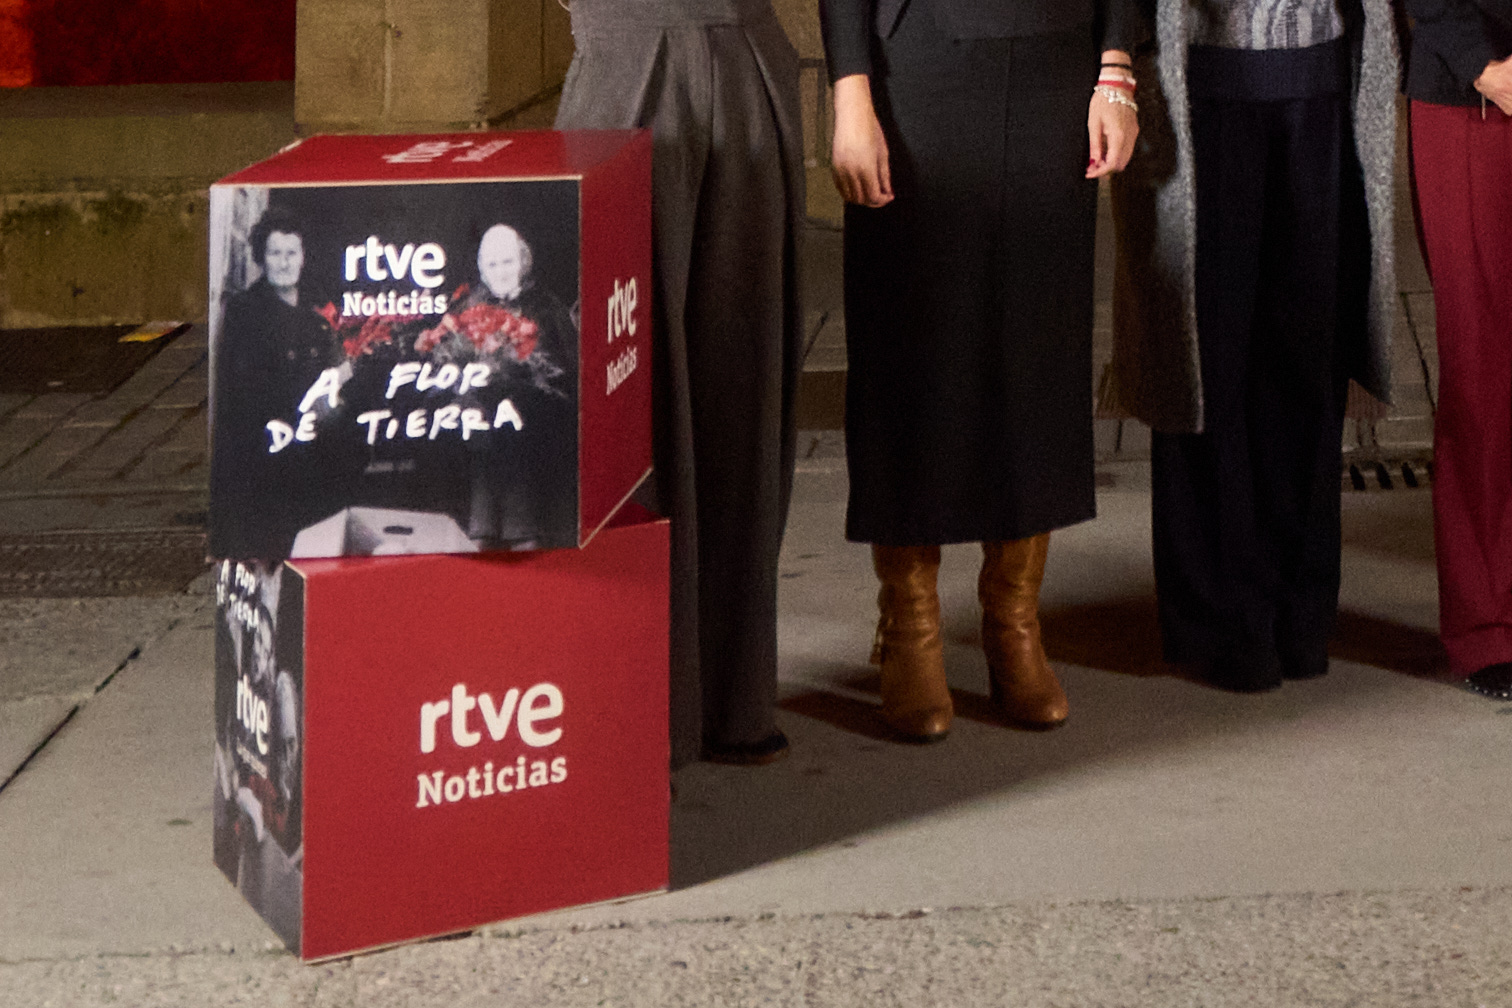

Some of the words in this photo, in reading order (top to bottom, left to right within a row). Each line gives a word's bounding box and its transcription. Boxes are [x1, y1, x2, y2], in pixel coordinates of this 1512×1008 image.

[344, 235, 447, 288] rtve
[342, 289, 448, 317] Noticias
[607, 276, 638, 344] rtve
[298, 366, 341, 414] A
[385, 361, 491, 399] FLOR
[266, 411, 318, 454] DE
[356, 398, 524, 445] TIERRA
[236, 672, 270, 756] rtve
[419, 681, 565, 754] rtve
[416, 755, 568, 808] Noticias
